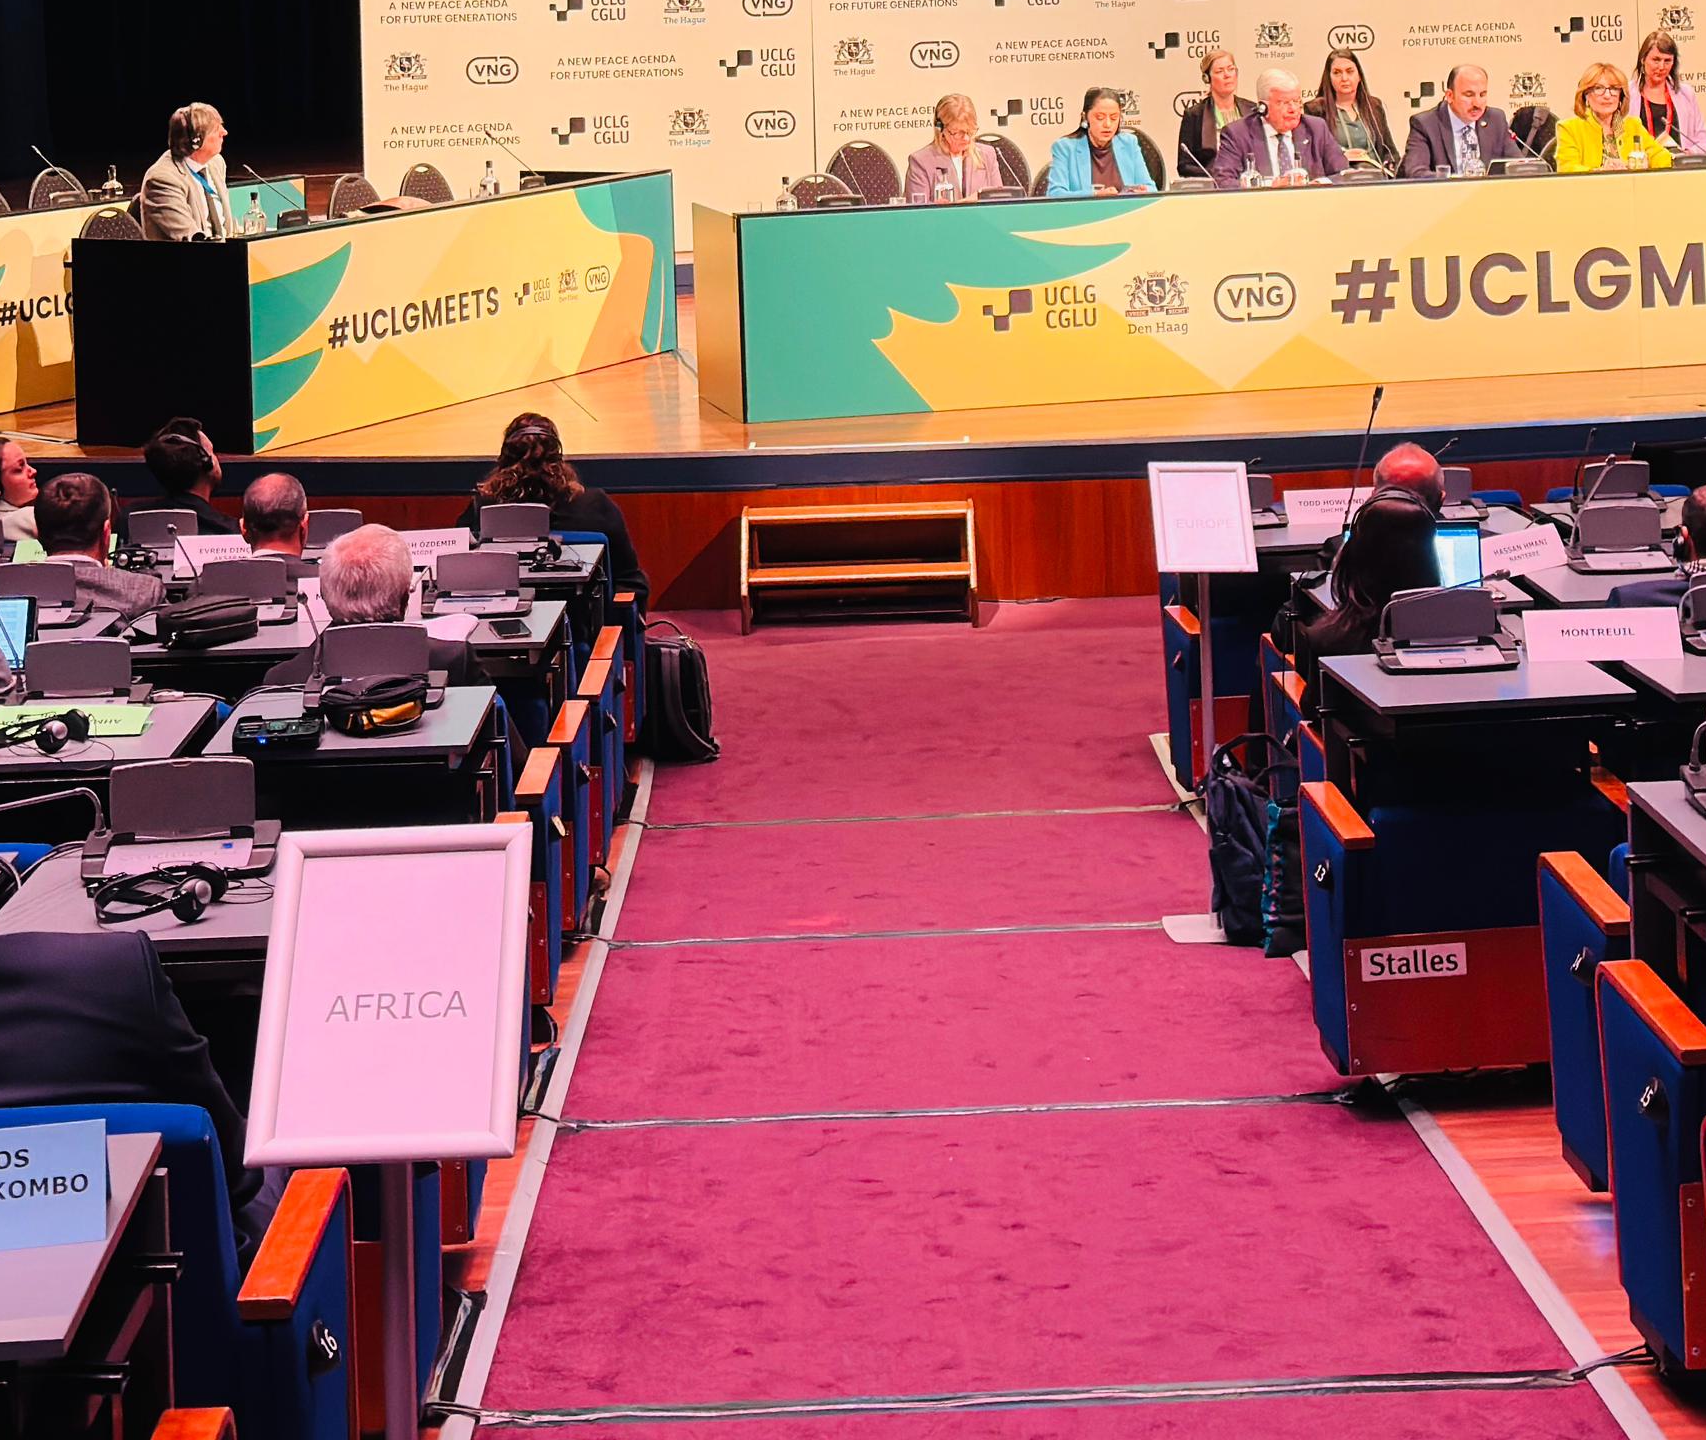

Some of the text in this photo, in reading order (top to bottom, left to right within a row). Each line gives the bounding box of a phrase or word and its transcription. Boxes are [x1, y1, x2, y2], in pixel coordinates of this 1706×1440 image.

[401, 0, 425, 9] NEW
[428, 0, 462, 9] PEACE
[464, 0, 508, 9] AGENDA
[380, 12, 517, 24] FOR FUTURE GENERATIONS
[591, 8, 626, 21] CGLU
[1336, 32, 1368, 44] VNG
[760, 48, 795, 62] UCLG
[475, 64, 511, 77] VNG
[761, 63, 796, 77] CGLU
[384, 83, 429, 93] The Hague
[589, 272, 607, 285] VNG
[533, 290, 551, 303] CGLU
[1044, 284, 1097, 307] UCLG
[1227, 285, 1285, 309] VNG
[328, 287, 500, 349] #UCLGMEETS
[1045, 307, 1098, 330] CGLU
[1128, 322, 1189, 335] Den Haag
[1175, 518, 1236, 529] EUROPE
[1561, 628, 1635, 637] MONTREUIL
[1369, 948, 1459, 976] Stalles
[325, 990, 468, 1022] AFRICA
[320, 1326, 340, 1360] 16
